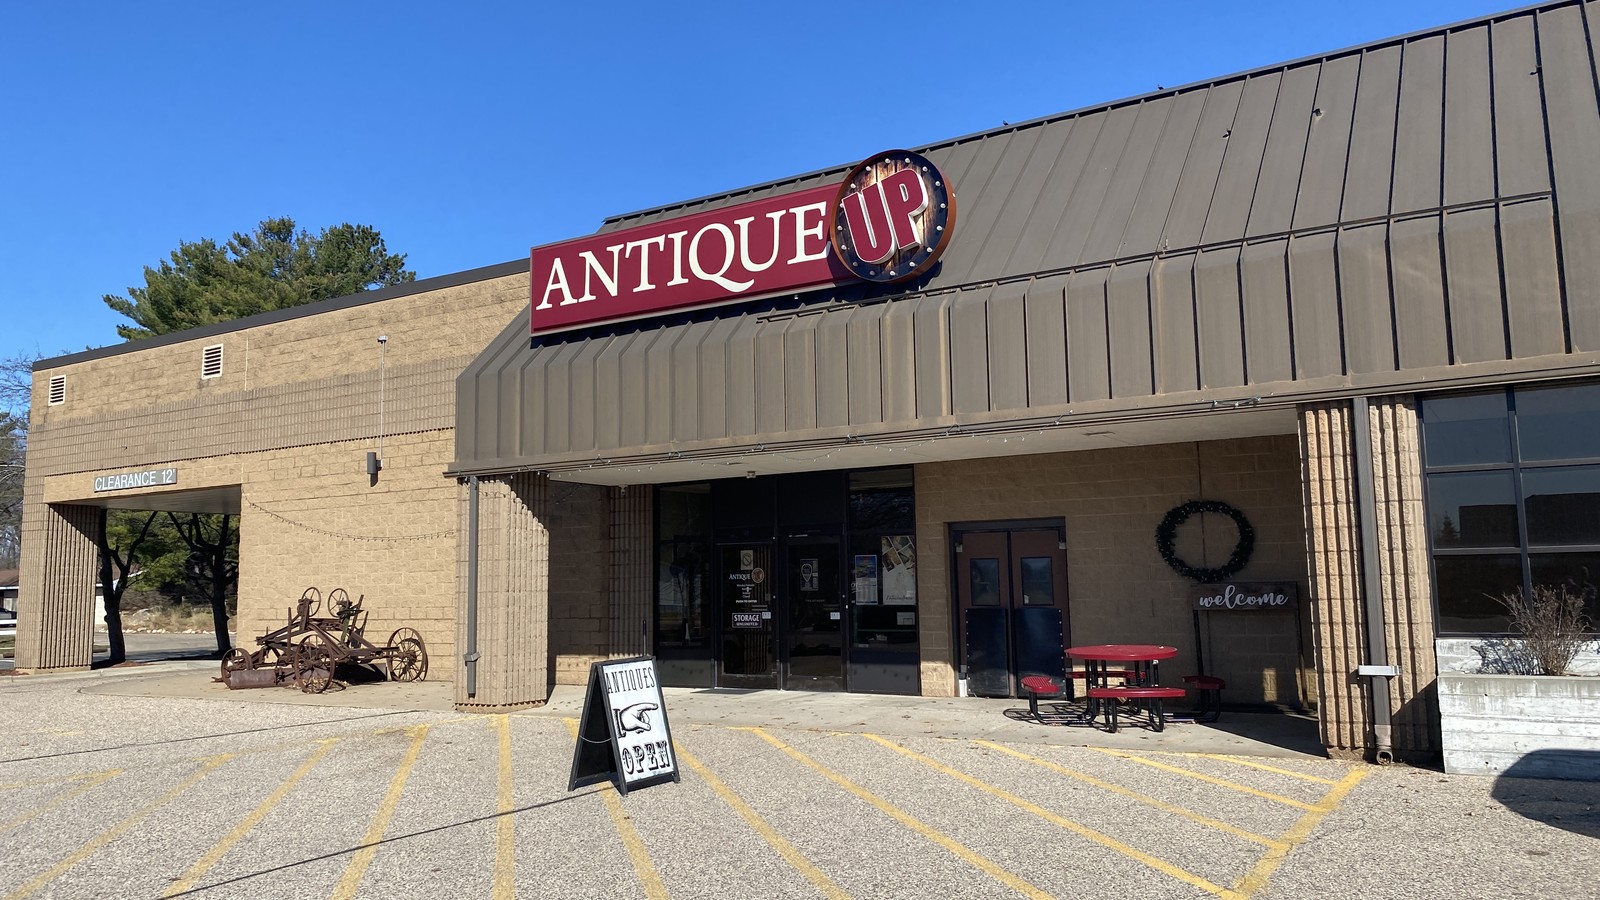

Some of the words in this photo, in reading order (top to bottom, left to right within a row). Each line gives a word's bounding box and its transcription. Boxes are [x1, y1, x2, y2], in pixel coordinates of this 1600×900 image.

[536, 201, 831, 310] ANTIQUE
[841, 168, 929, 266] UP
[94, 471, 157, 491] CLEARANCE
[161, 469, 176, 484] 12'
[729, 573, 751, 581] ANTIQUE
[1199, 585, 1289, 609] welcome
[733, 614, 760, 622] STORAGE
[604, 667, 656, 695] ANTIQUES
[621, 740, 671, 775] OPEN
